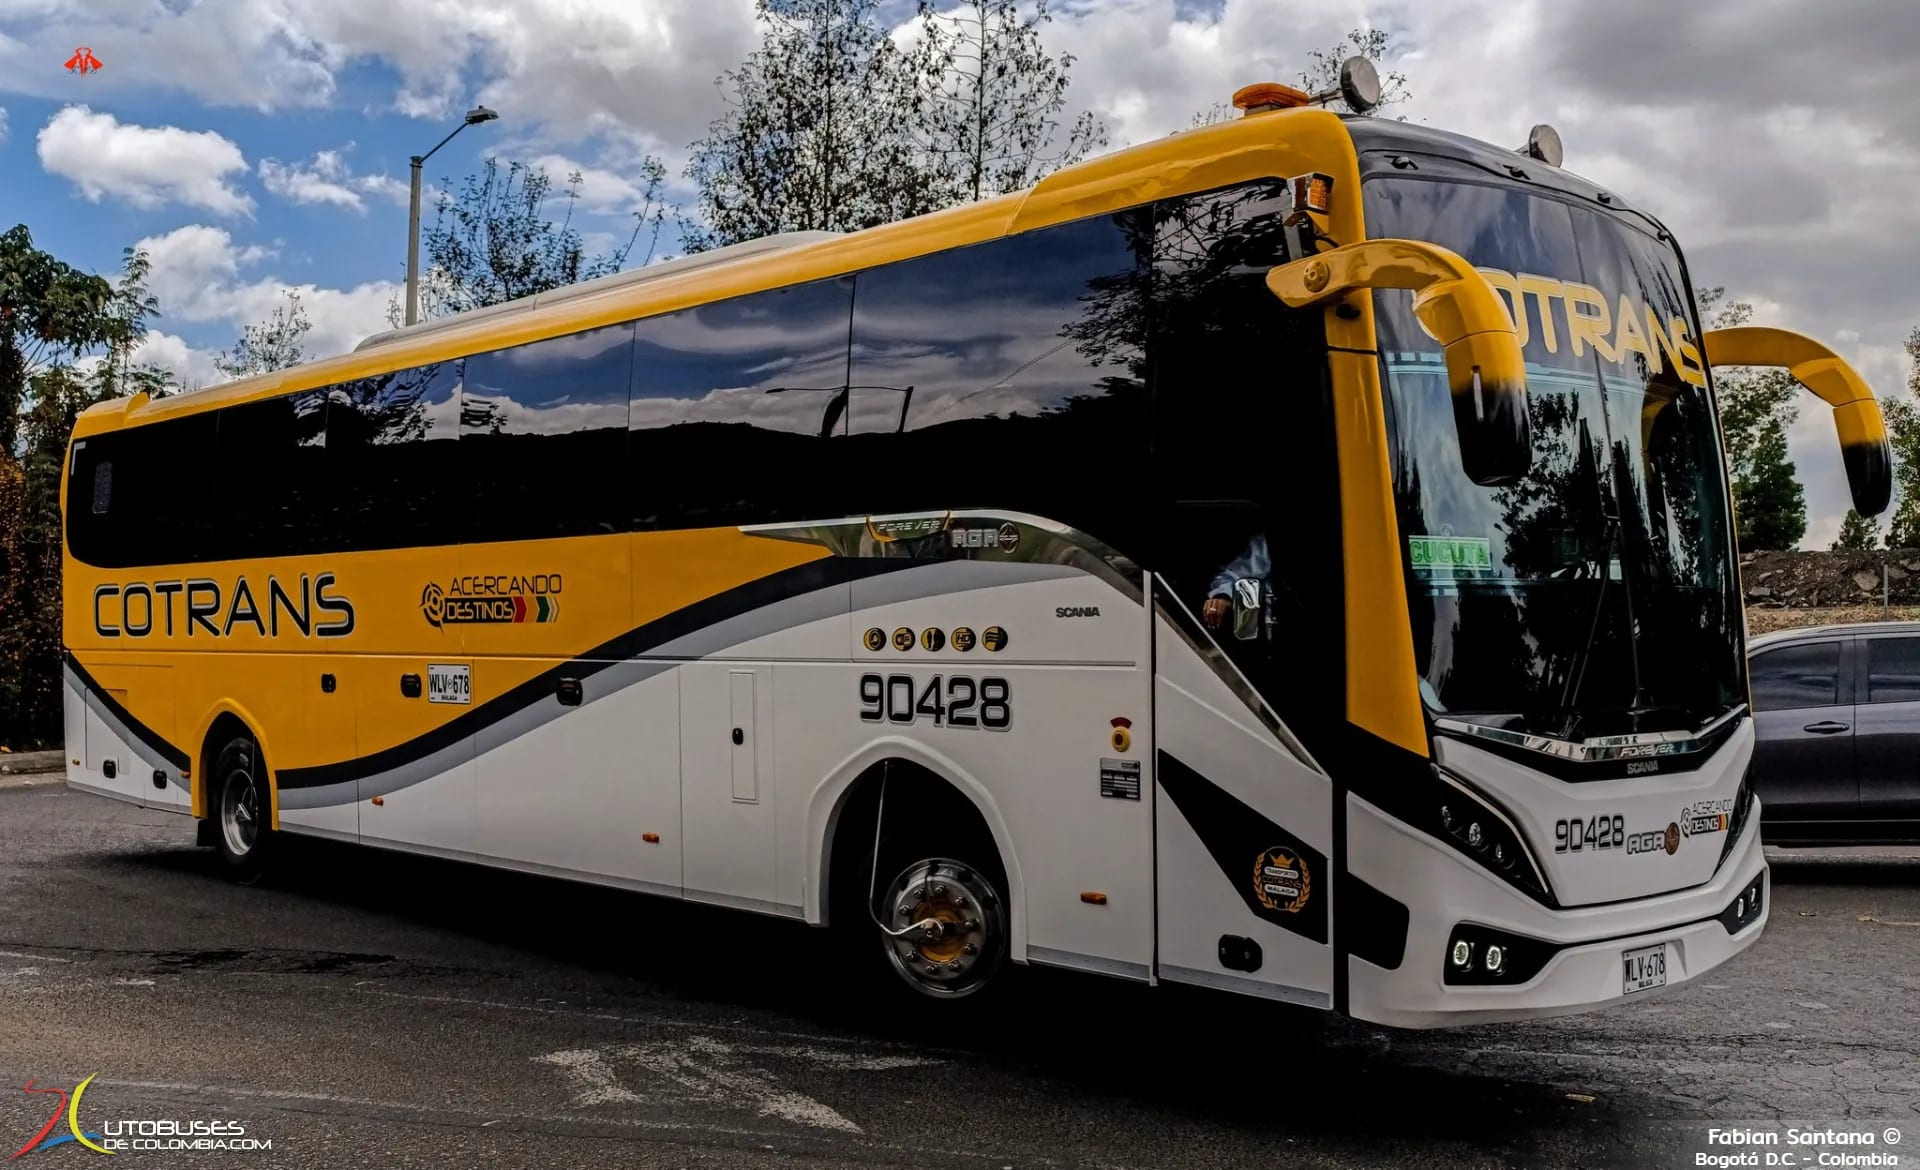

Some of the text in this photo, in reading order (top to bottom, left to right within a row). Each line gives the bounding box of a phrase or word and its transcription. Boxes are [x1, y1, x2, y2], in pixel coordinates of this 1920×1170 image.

[1412, 266, 1707, 389] OTRANS
[878, 520, 941, 532] FOREVER
[951, 528, 999, 548] AGA
[449, 574, 562, 595] ACERCANDO
[94, 572, 355, 639] COTRANS
[446, 601, 514, 620] DESTINOS
[1055, 607, 1101, 618] SCANIA
[859, 672, 1013, 732] 90428
[1620, 744, 1674, 757] FOREVER
[1627, 760, 1659, 775] SCANIA
[1555, 815, 1625, 855] 90428
[1627, 830, 1666, 855] AGA
